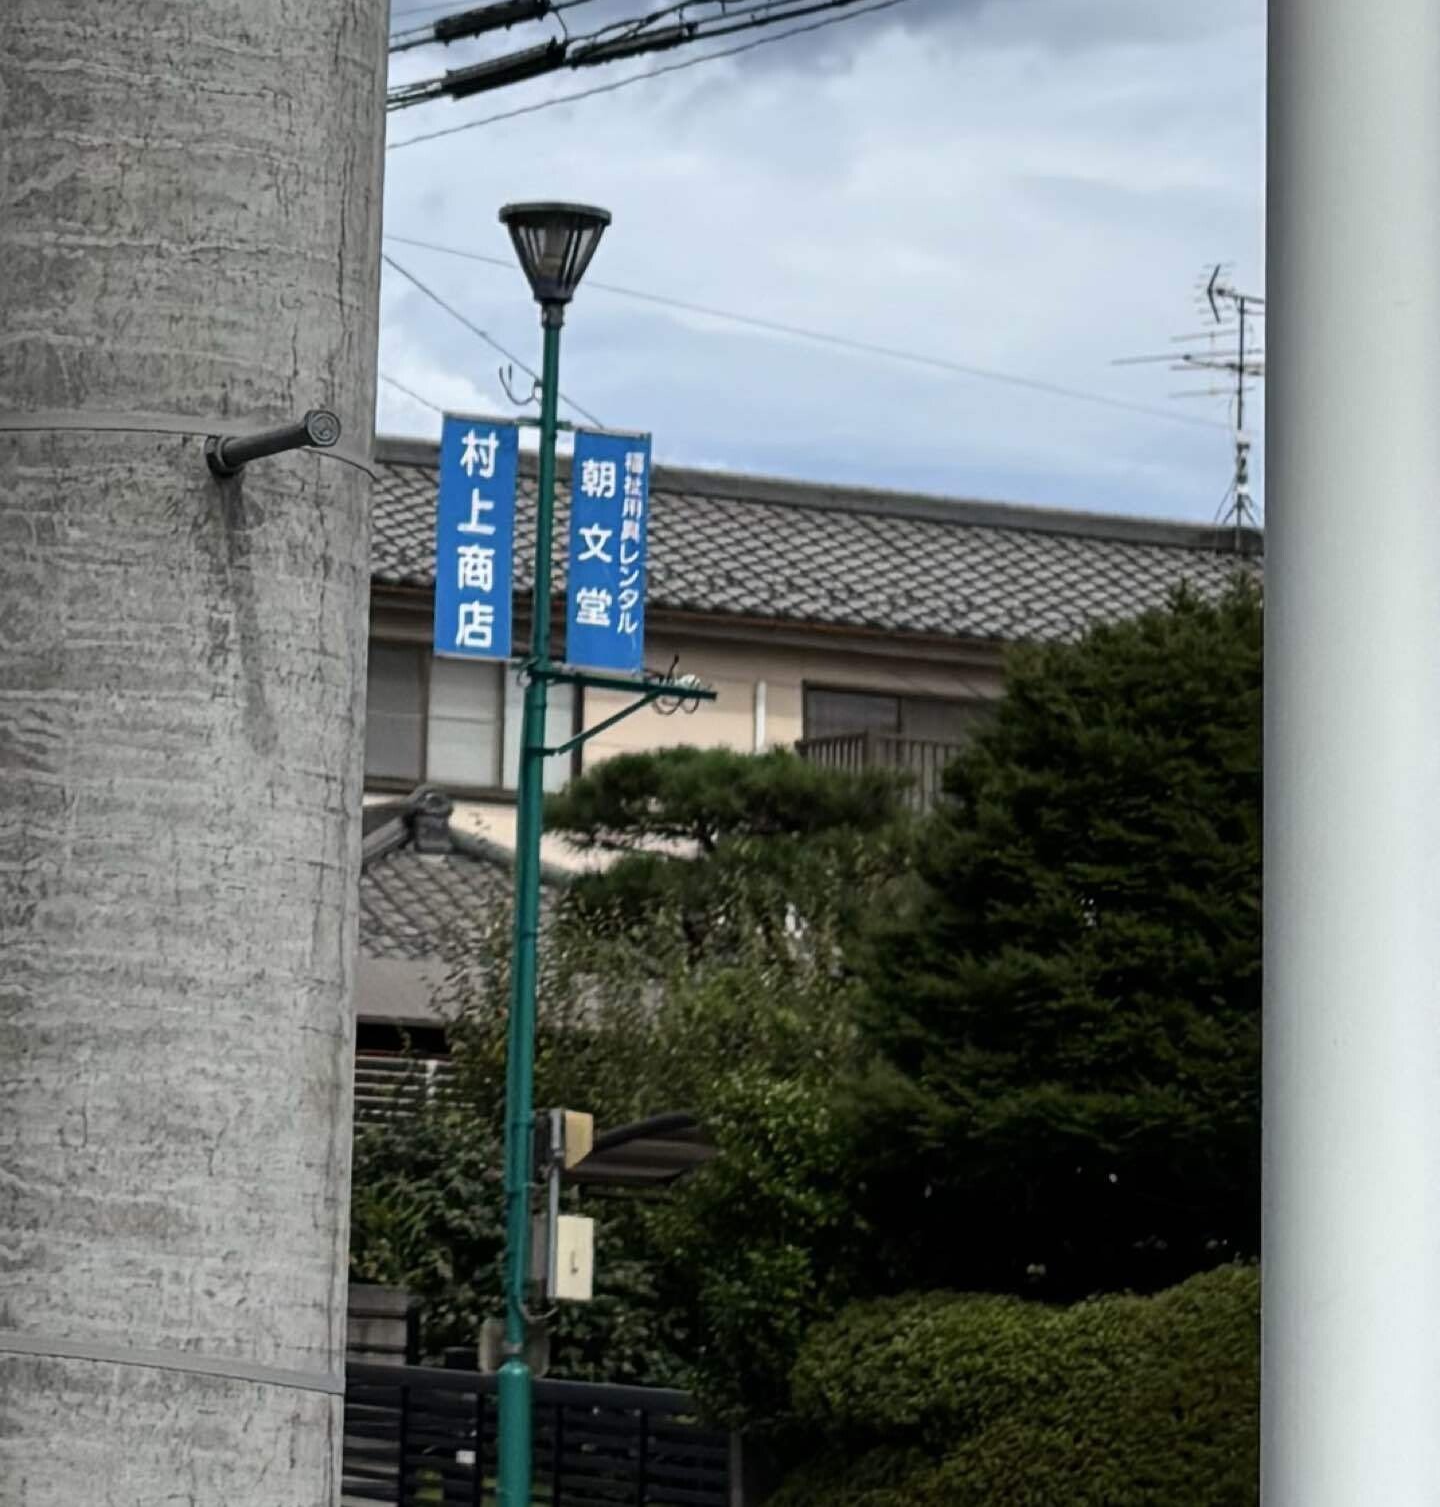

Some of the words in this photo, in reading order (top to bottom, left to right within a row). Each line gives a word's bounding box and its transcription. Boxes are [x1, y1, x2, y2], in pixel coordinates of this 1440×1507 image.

[455, 428, 499, 649] 村上商店
[575, 458, 617, 628] 朝文堂
